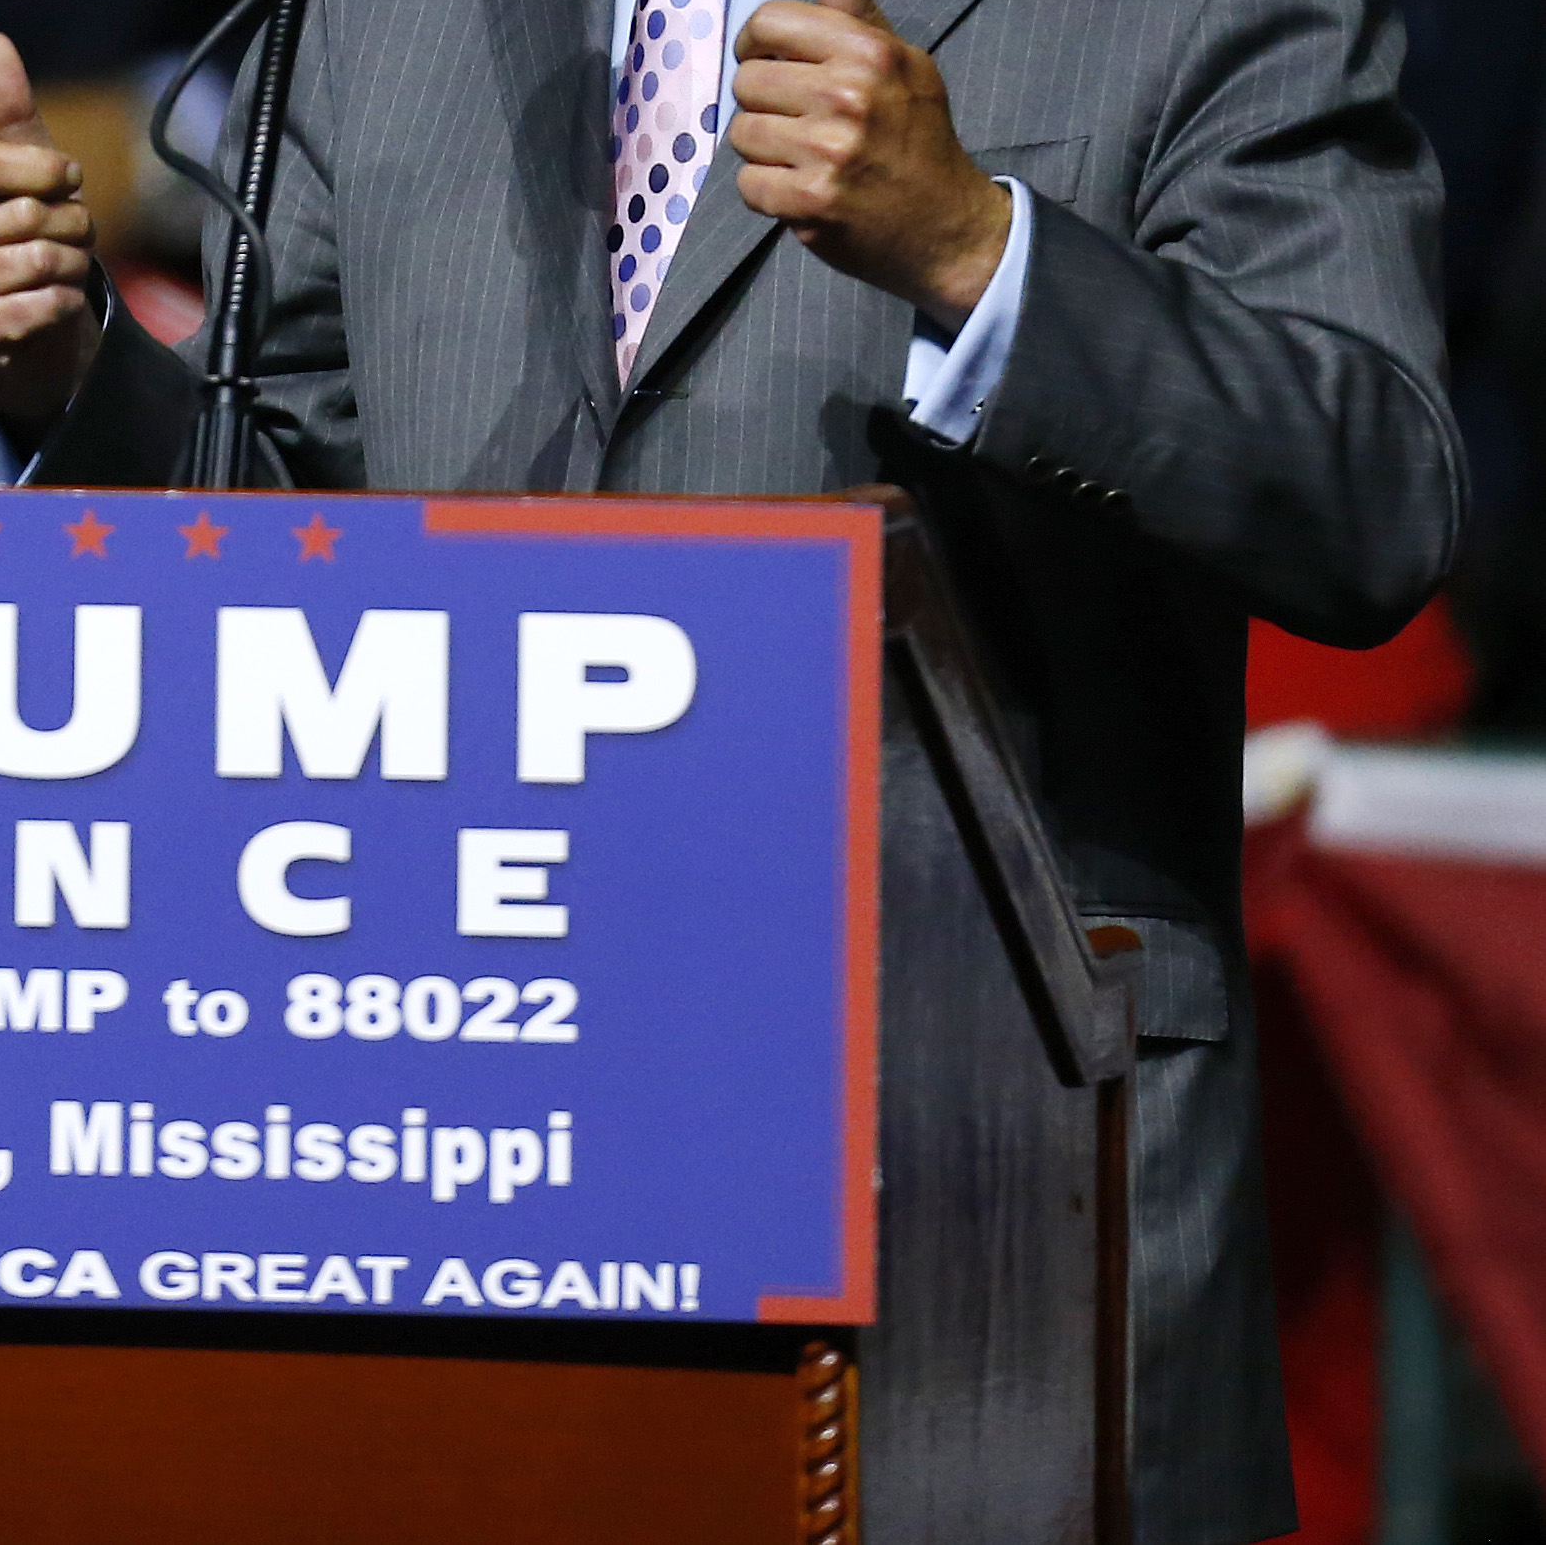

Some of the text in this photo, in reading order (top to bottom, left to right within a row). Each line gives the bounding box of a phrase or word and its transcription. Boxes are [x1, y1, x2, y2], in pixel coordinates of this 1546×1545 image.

[163, 980, 248, 1036] to
[285, 974, 578, 1042] 88022
[50, 1101, 571, 1203] Mississippi
[140, 1252, 408, 1304] GREAT
[423, 1259, 699, 1312] AGAIN!
